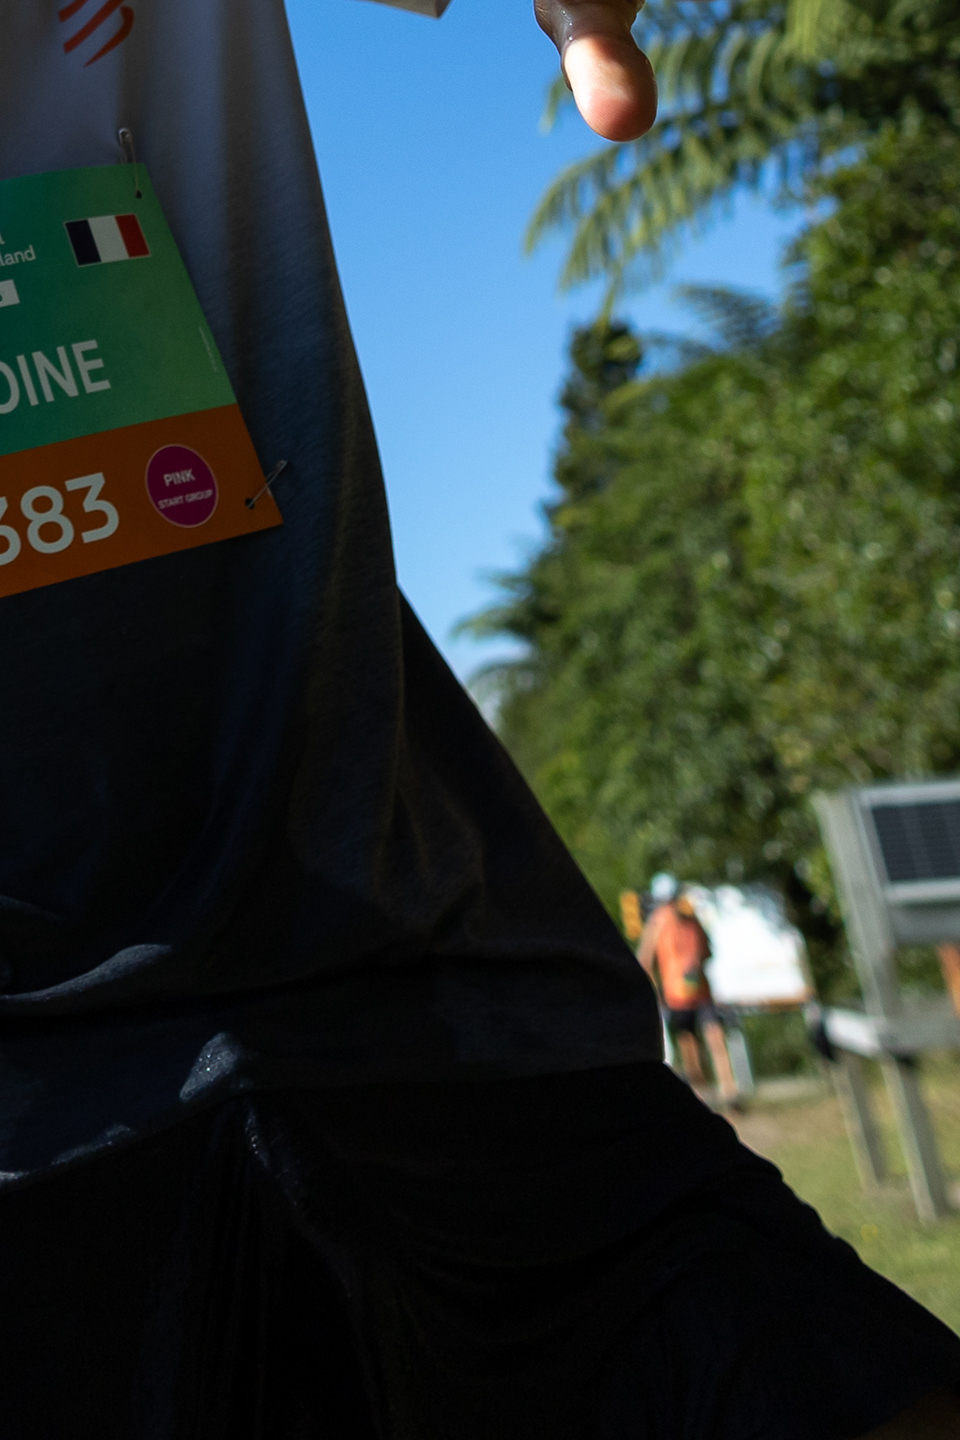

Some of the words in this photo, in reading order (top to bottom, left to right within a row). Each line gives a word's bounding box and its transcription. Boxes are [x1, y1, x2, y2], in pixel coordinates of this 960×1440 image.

[162, 468, 197, 488] PINK
[157, 495, 185, 510] START
[184, 488, 214, 503] GROUP
